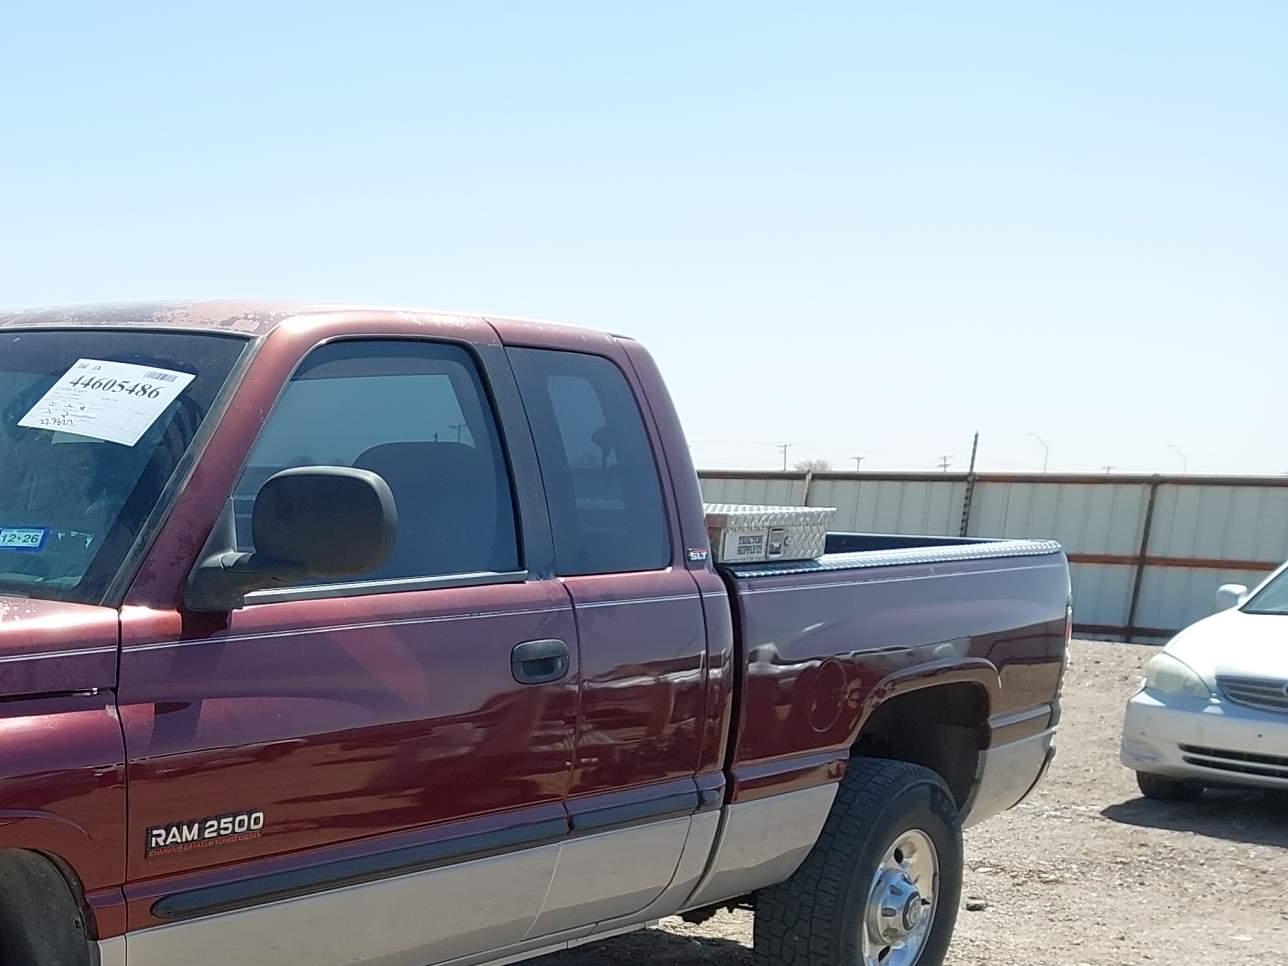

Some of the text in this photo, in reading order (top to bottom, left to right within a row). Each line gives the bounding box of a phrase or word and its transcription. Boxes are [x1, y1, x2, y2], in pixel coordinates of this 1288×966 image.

[70, 375, 163, 399] 44605486
[690, 551, 707, 560] SLT
[151, 823, 199, 847] RAM
[203, 812, 264, 838] 2500
